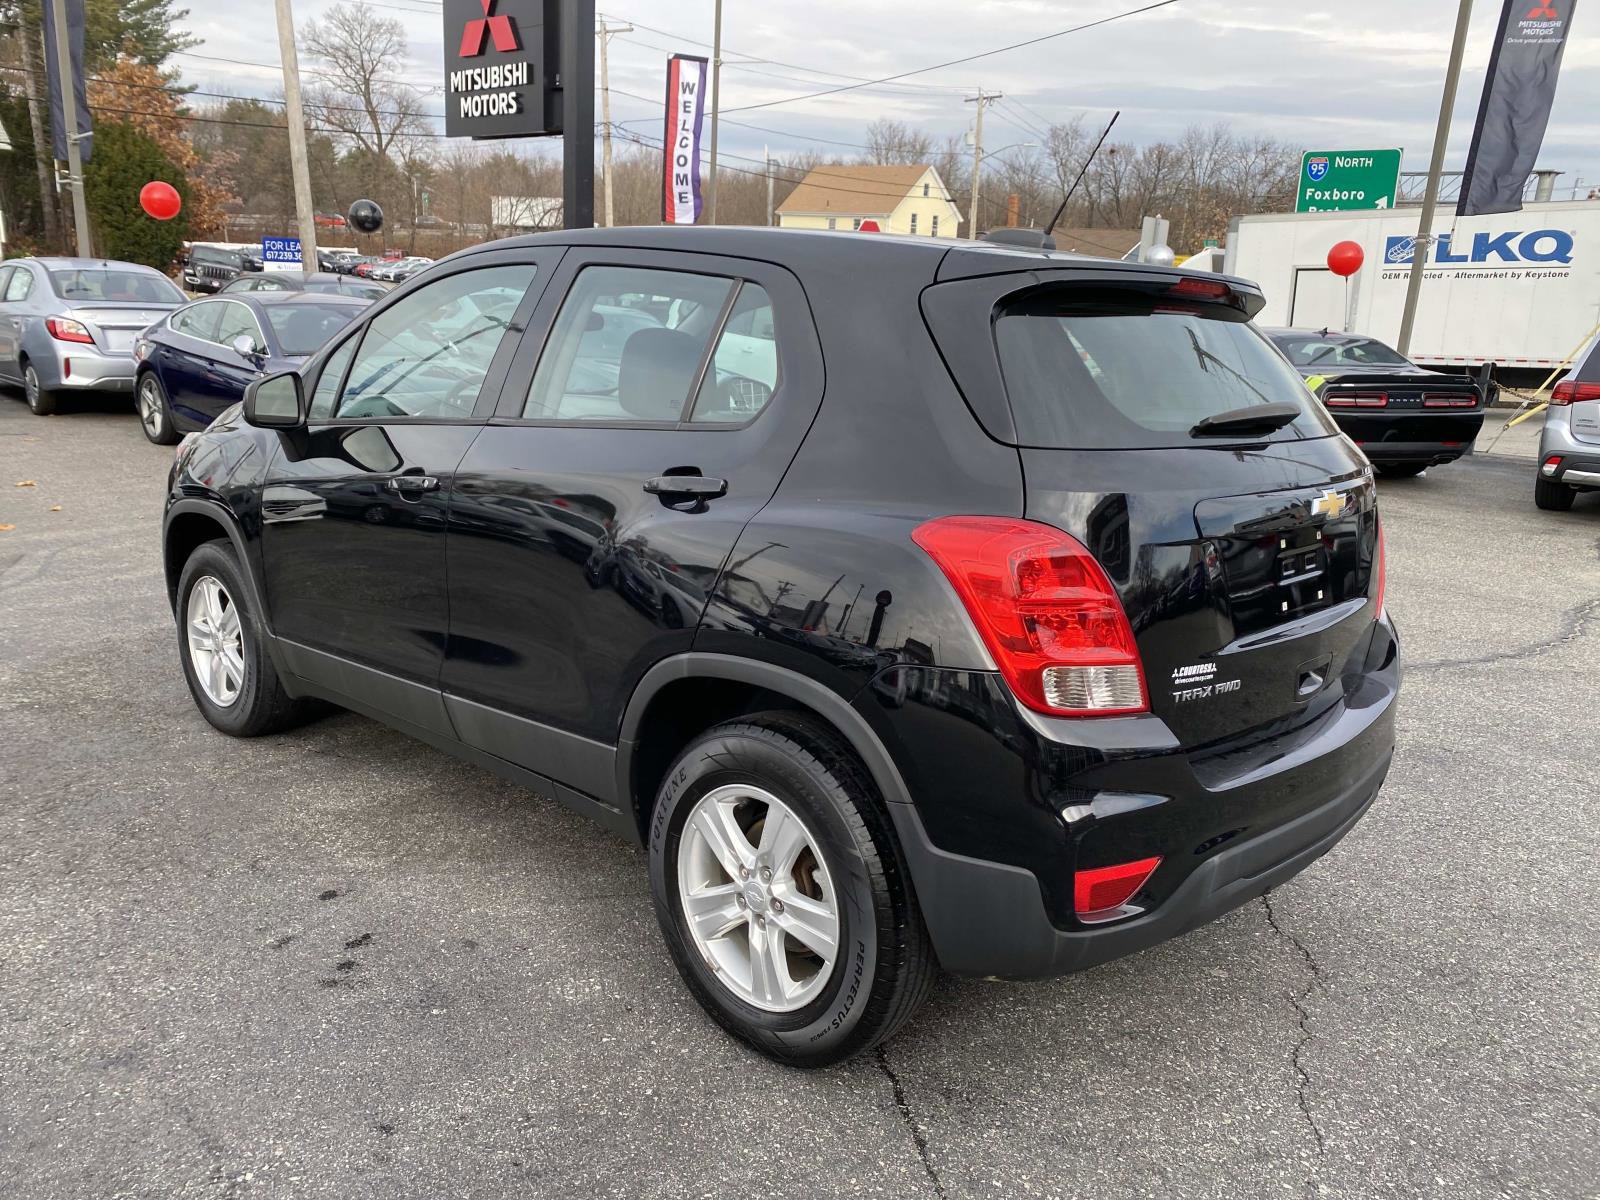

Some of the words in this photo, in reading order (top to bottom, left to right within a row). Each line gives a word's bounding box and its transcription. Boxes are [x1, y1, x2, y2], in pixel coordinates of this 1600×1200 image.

[1518, 20, 1562, 28] MITSUBISHI
[450, 61, 528, 93] MITSUBISHI
[460, 91, 518, 118] MOTORS
[675, 81, 696, 204] WELCOME
[1311, 163, 1325, 175] 95
[1305, 188, 1365, 200] Foxboro
[265, 240, 284, 250] FOR
[285, 241, 302, 251] LEA
[266, 250, 302, 260] 617.239.36
[1435, 229, 1574, 264] LKQ
[1382, 272, 1401, 280] OEM
[1403, 271, 1443, 280] Rcled
[1454, 271, 1508, 279] Aftermarket
[1511, 271, 1522, 279] by
[1525, 271, 1570, 279] Keystone
[1172, 685, 1213, 703] TRAX
[1215, 679, 1241, 695] AWD
[652, 766, 687, 855] FORTUNE
[831, 940, 865, 1030] PERFECTUS
